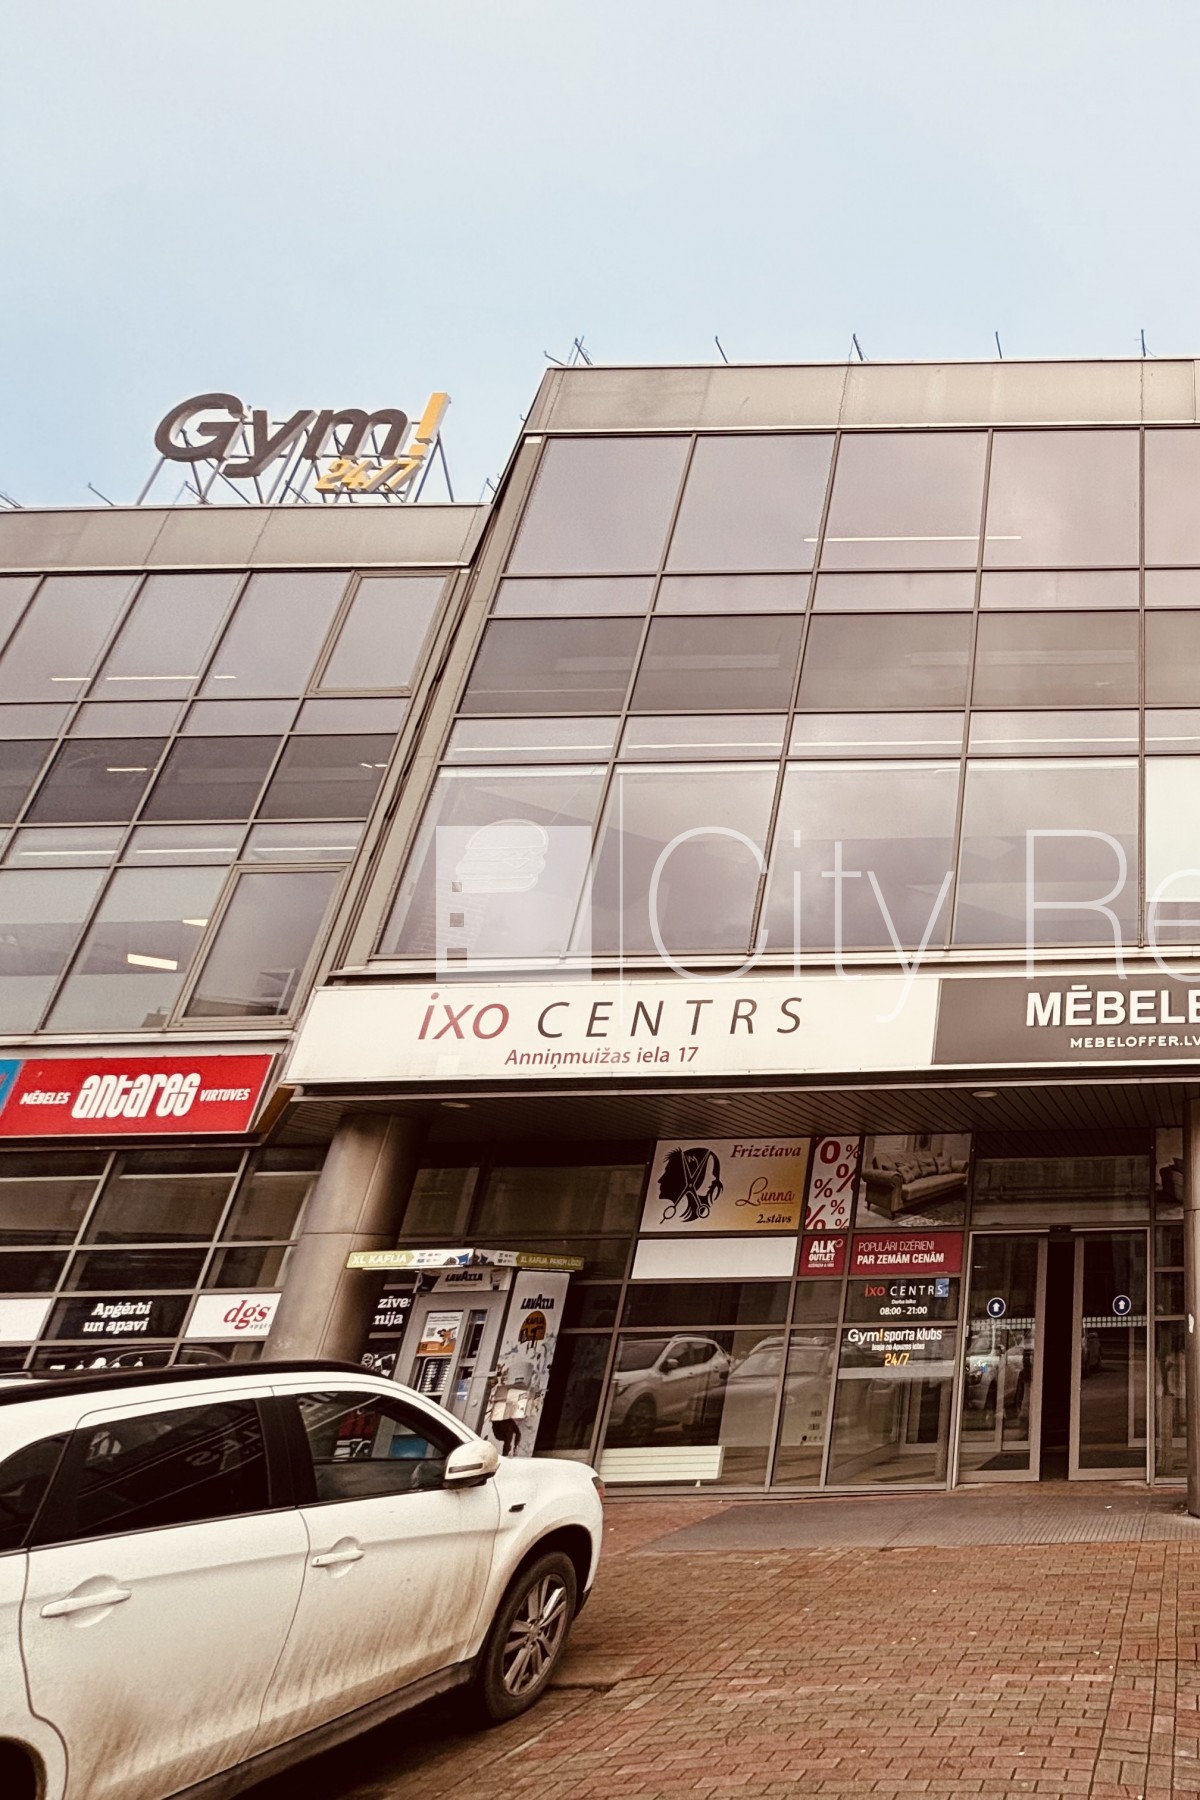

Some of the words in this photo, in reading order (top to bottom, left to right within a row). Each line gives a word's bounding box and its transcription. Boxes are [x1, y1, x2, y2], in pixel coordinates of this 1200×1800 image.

[155, 392, 451, 478] Gym!
[315, 459, 424, 494] 24/7
[537, 997, 803, 1039] CENTRS
[504, 1047, 632, 1069] Anniņmuižas
[636, 1046, 671, 1064] iela
[678, 1046, 699, 1063] 17
[20, 1090, 71, 1105] MĒBELES
[71, 1072, 201, 1119] antares
[200, 1088, 252, 1102] VIRTUVES
[730, 1144, 801, 1158] Frizētava
[735, 1177, 795, 1206] Lunna
[810, 1240, 836, 1253] ALK
[859, 1241, 898, 1252] POPULĀRI
[899, 1240, 935, 1251] DZĒRIENI
[352, 1254, 367, 1265] XL
[369, 1253, 408, 1265] KAFIJA
[857, 1255, 875, 1265] PAR
[877, 1253, 910, 1264] ZEMĀM
[912, 1252, 945, 1263] CENĀM
[890, 1285, 943, 1296] CENTRS
[91, 1301, 153, 1318] Apģērbi
[879, 1307, 902, 1315] 08:00
[907, 1306, 927, 1315] 21:00
[83, 1321, 104, 1332] un
[105, 1318, 150, 1334] apavi
[848, 1328, 883, 1344] Gym!
[884, 1330, 915, 1342] sporta
[917, 1328, 942, 1340] klubs
[884, 1353, 910, 1367] 24/7
